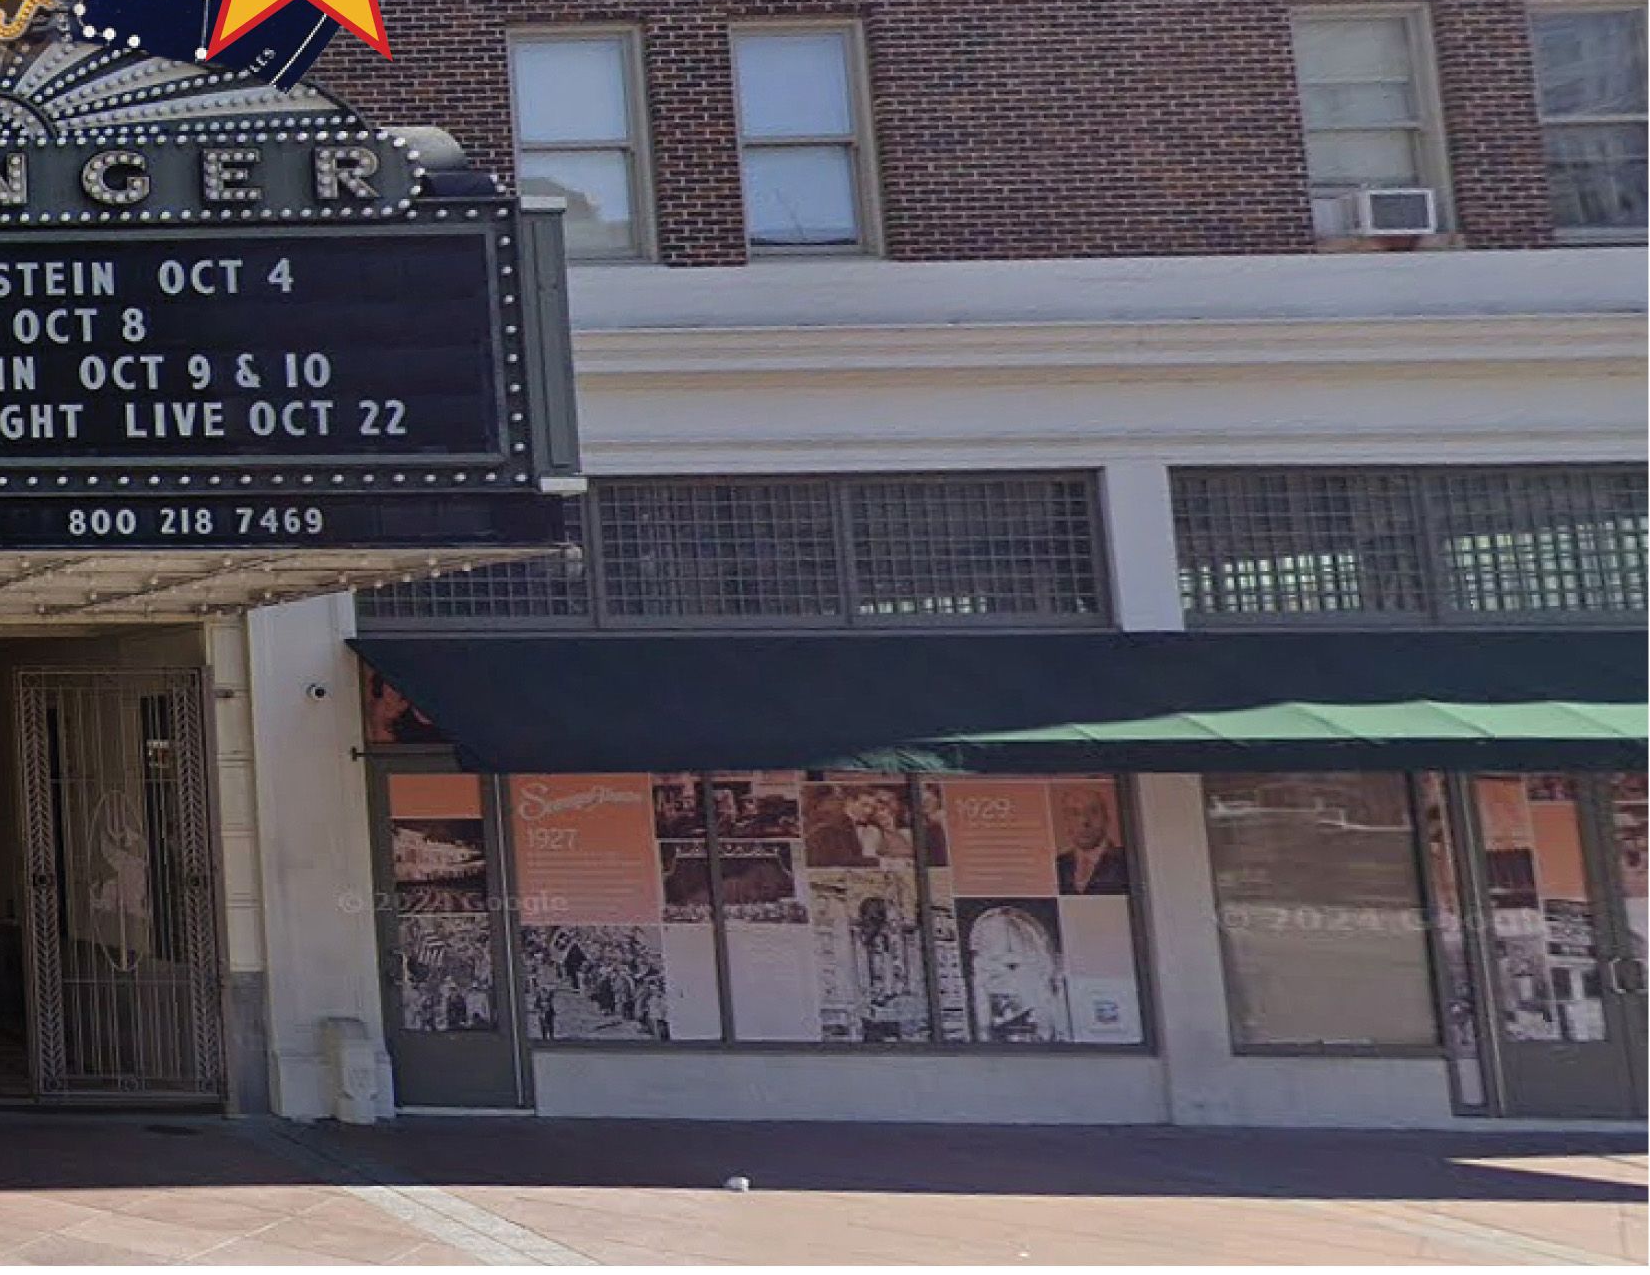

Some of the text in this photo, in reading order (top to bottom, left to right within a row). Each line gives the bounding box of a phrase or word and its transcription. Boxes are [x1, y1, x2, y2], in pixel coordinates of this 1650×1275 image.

[160, 260, 241, 293] OCT
[269, 258, 293, 291] 4
[14, 309, 96, 343] OCT
[123, 309, 145, 341] 8
[81, 356, 162, 389] OCT
[188, 355, 210, 389] 9
[237, 354, 259, 387] &
[287, 354, 330, 387] 10
[127, 403, 224, 436] LIVE
[250, 401, 332, 435] OCT
[361, 400, 406, 434] 22
[69, 509, 137, 535] 800
[161, 508, 213, 534] 218
[236, 507, 323, 533] 7469
[526, 828, 578, 849] 1927
